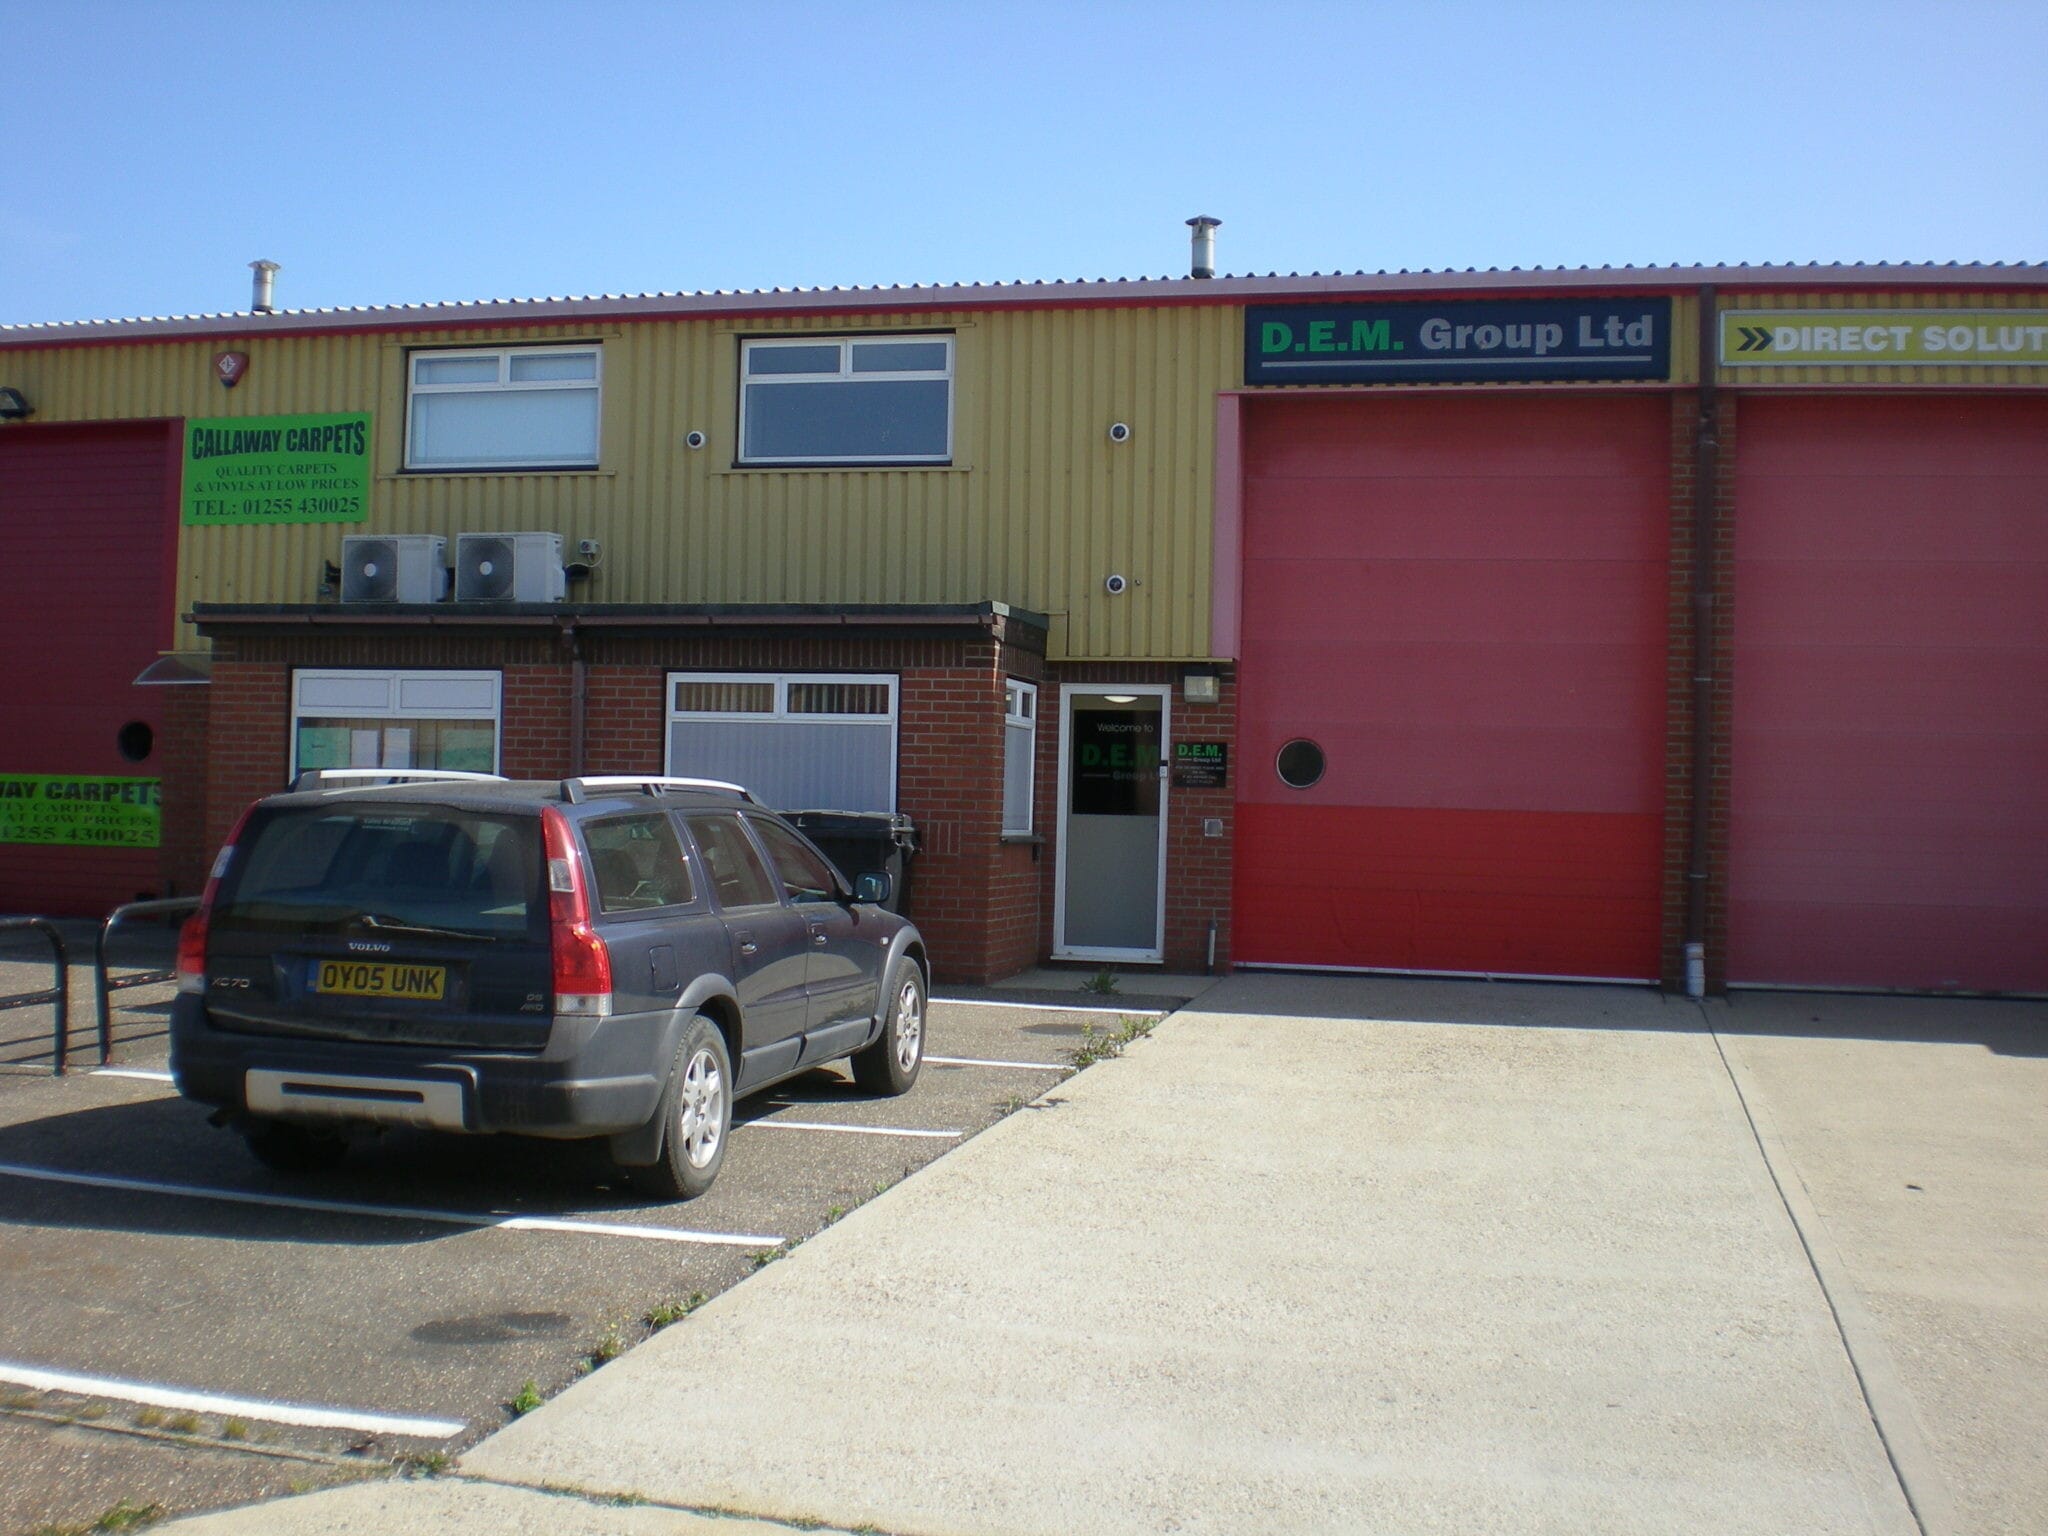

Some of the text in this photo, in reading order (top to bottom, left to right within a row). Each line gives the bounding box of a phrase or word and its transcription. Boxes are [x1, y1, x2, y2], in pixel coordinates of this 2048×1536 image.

[1262, 315, 1653, 354] D.E.M. Group Ltd
[1774, 325, 1912, 351] DIRECT
[192, 420, 366, 460] CALLAWAY CARPETS
[215, 463, 337, 478] QUALITY CARPETS
[193, 478, 359, 493] & VINYLS AT LOW PRICES
[194, 496, 360, 516] TEL: 01255 430025
[1097, 722, 1154, 733] Welcome to
[1178, 744, 1223, 757] D.E.M.
[66, 827, 155, 843] 430025
[349, 942, 391, 953] VOLVO
[323, 964, 440, 994] OY05 UNK
